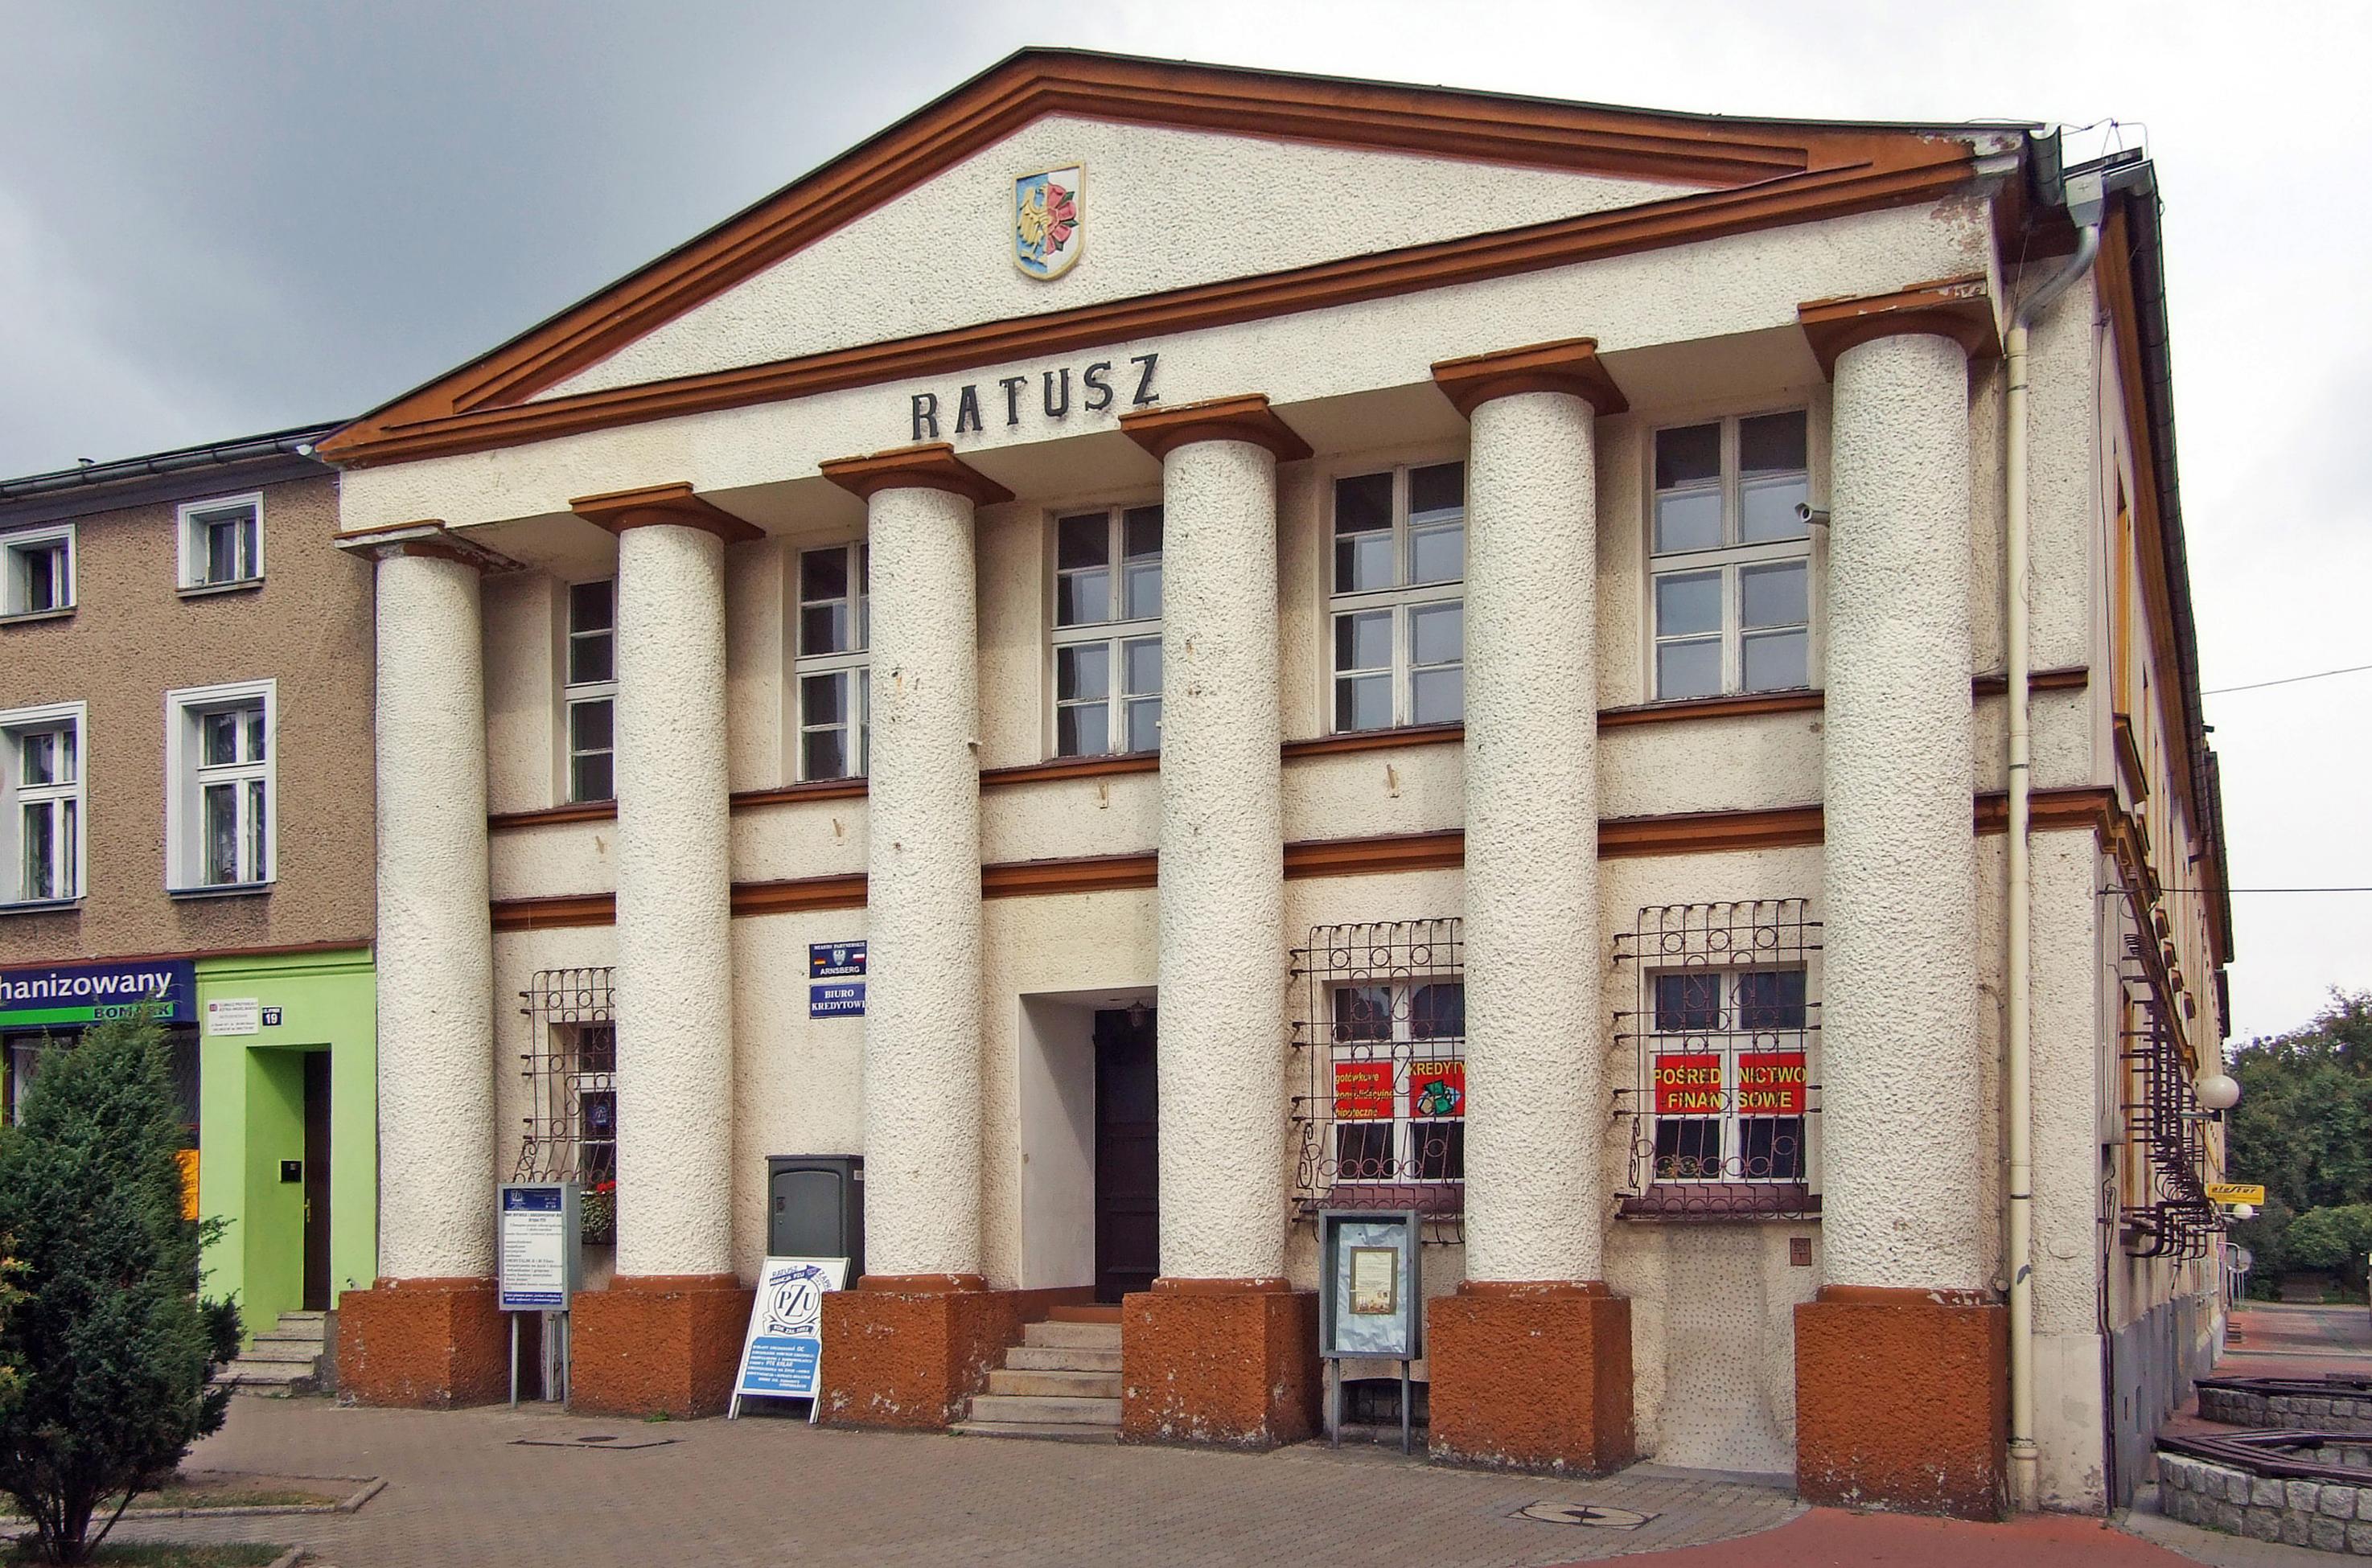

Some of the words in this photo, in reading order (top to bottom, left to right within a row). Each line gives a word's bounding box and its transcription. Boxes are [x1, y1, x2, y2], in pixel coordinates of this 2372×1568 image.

[911, 353, 1160, 440] RATUSZ
[820, 966, 860, 975] ARNSBERG
[824, 989, 854, 999] BIURO
[265, 1013, 278, 1024] 19
[1409, 1061, 1466, 1076] KREDYTY
[777, 1284, 816, 1316] PZU
